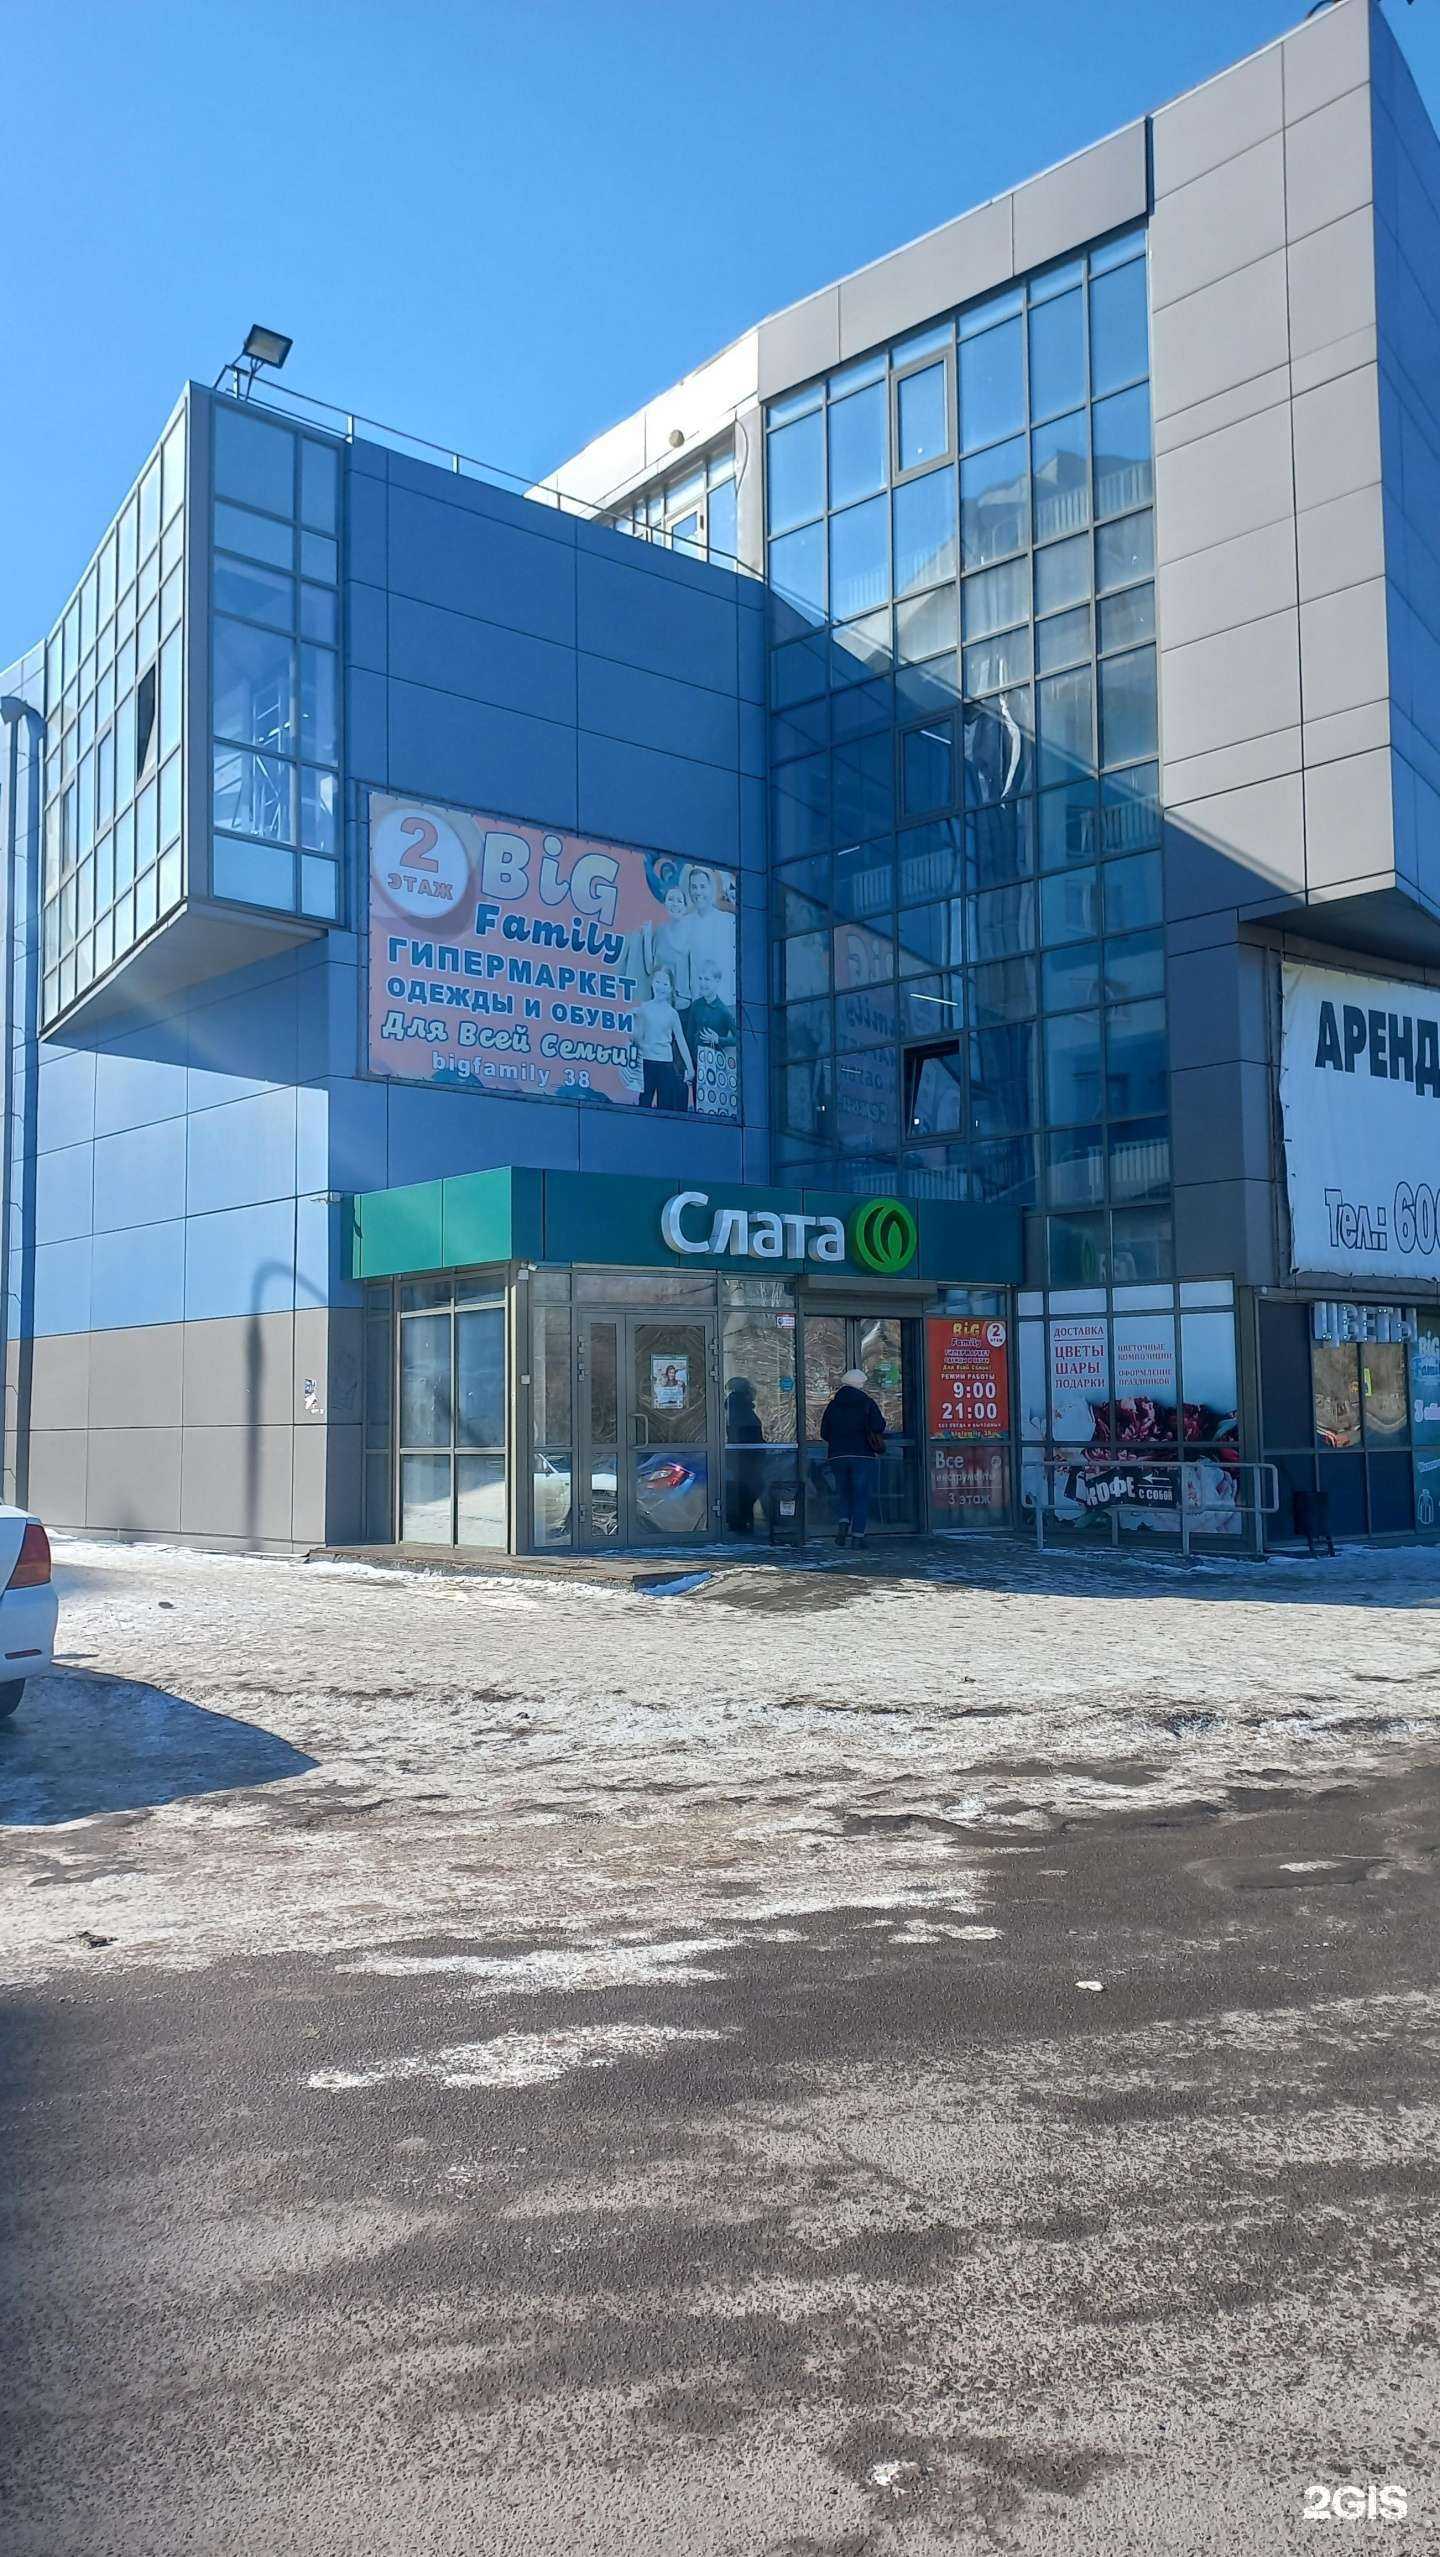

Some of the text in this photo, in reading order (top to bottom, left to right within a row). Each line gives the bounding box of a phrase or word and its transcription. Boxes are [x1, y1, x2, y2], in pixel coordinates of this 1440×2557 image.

[400, 817, 439, 873] 2
[387, 873, 454, 901] ЭТАЖ
[480, 831, 621, 926] BiG
[475, 903, 625, 966] Family
[388, 936, 637, 1002] ГИПЕРМАРКЕТ
[387, 976, 633, 1034] ОДЕЖДЫ И ОБУВИ
[381, 1010, 640, 1068] Для Всей Семьи!
[1315, 1000, 1440, 1098] АРЕНД
[432, 1051, 591, 1089] bigfamily_38
[661, 1191, 846, 1263] Слата
[1324, 1181, 1440, 1255] Тел.: 60
[992, 1324, 1001, 1337] 2
[1054, 1325, 1104, 1337] ДОСТАВКА
[1314, 1301, 1418, 1347] ЦВЕТЫ
[1055, 1344, 1104, 1359] ЦВЕТЫ
[1056, 1362, 1100, 1375] ШАРЫ
[953, 1381, 996, 1399] 9:00
[1055, 1378, 1105, 1389] ПОДАРКИ
[942, 1402, 997, 1419] 21:00
[935, 1450, 964, 1469] Все
[1085, 1476, 1136, 1506] КОФЕ
